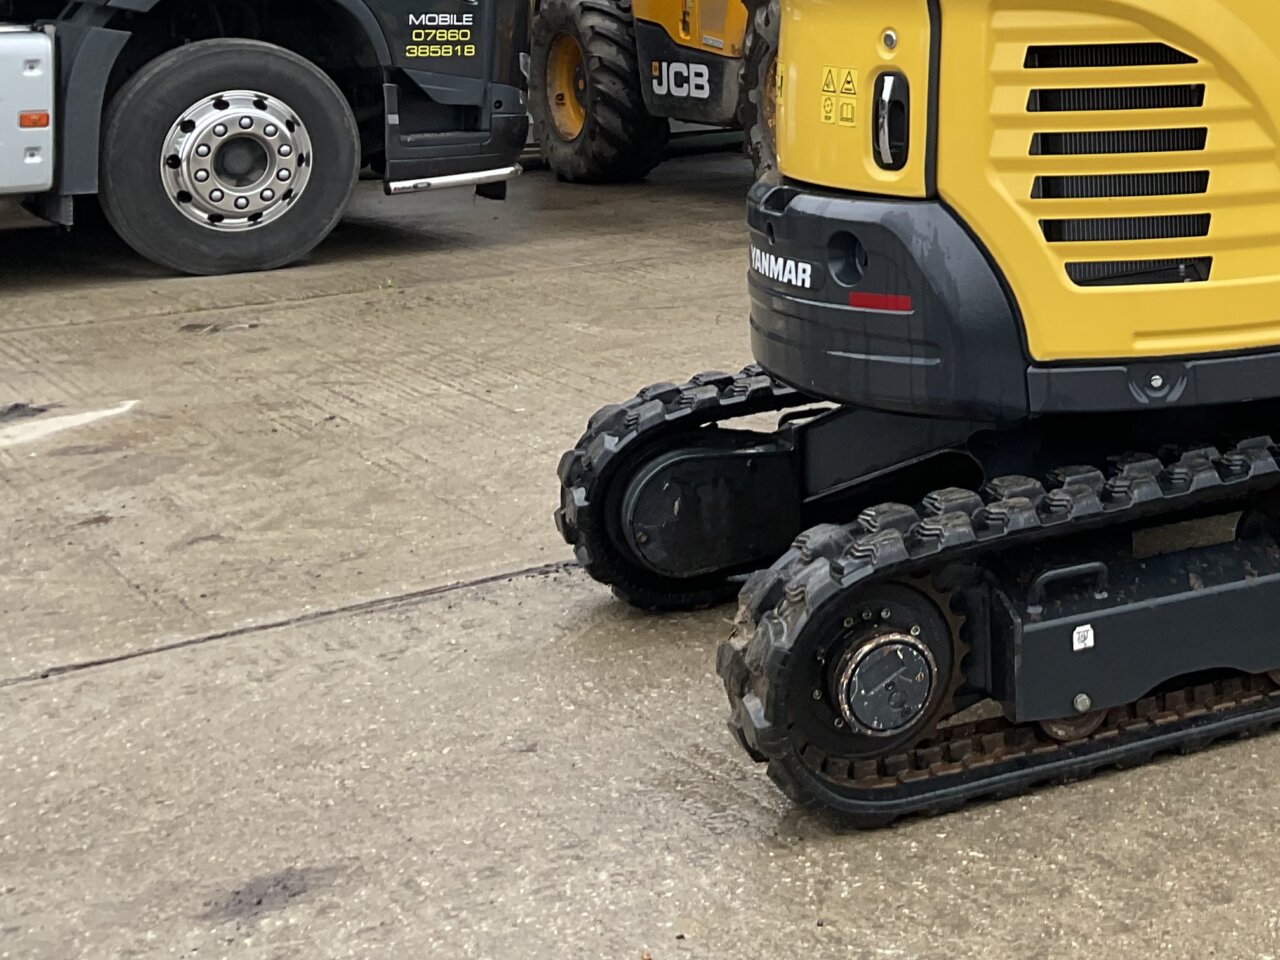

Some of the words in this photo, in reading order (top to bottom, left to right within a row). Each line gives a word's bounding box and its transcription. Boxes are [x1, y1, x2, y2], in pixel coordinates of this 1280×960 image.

[408, 13, 473, 25] MOBILE
[412, 29, 470, 41] 07860
[405, 44, 475, 57] 385818
[652, 61, 710, 98] JCB
[750, 244, 812, 288] YANMAR
